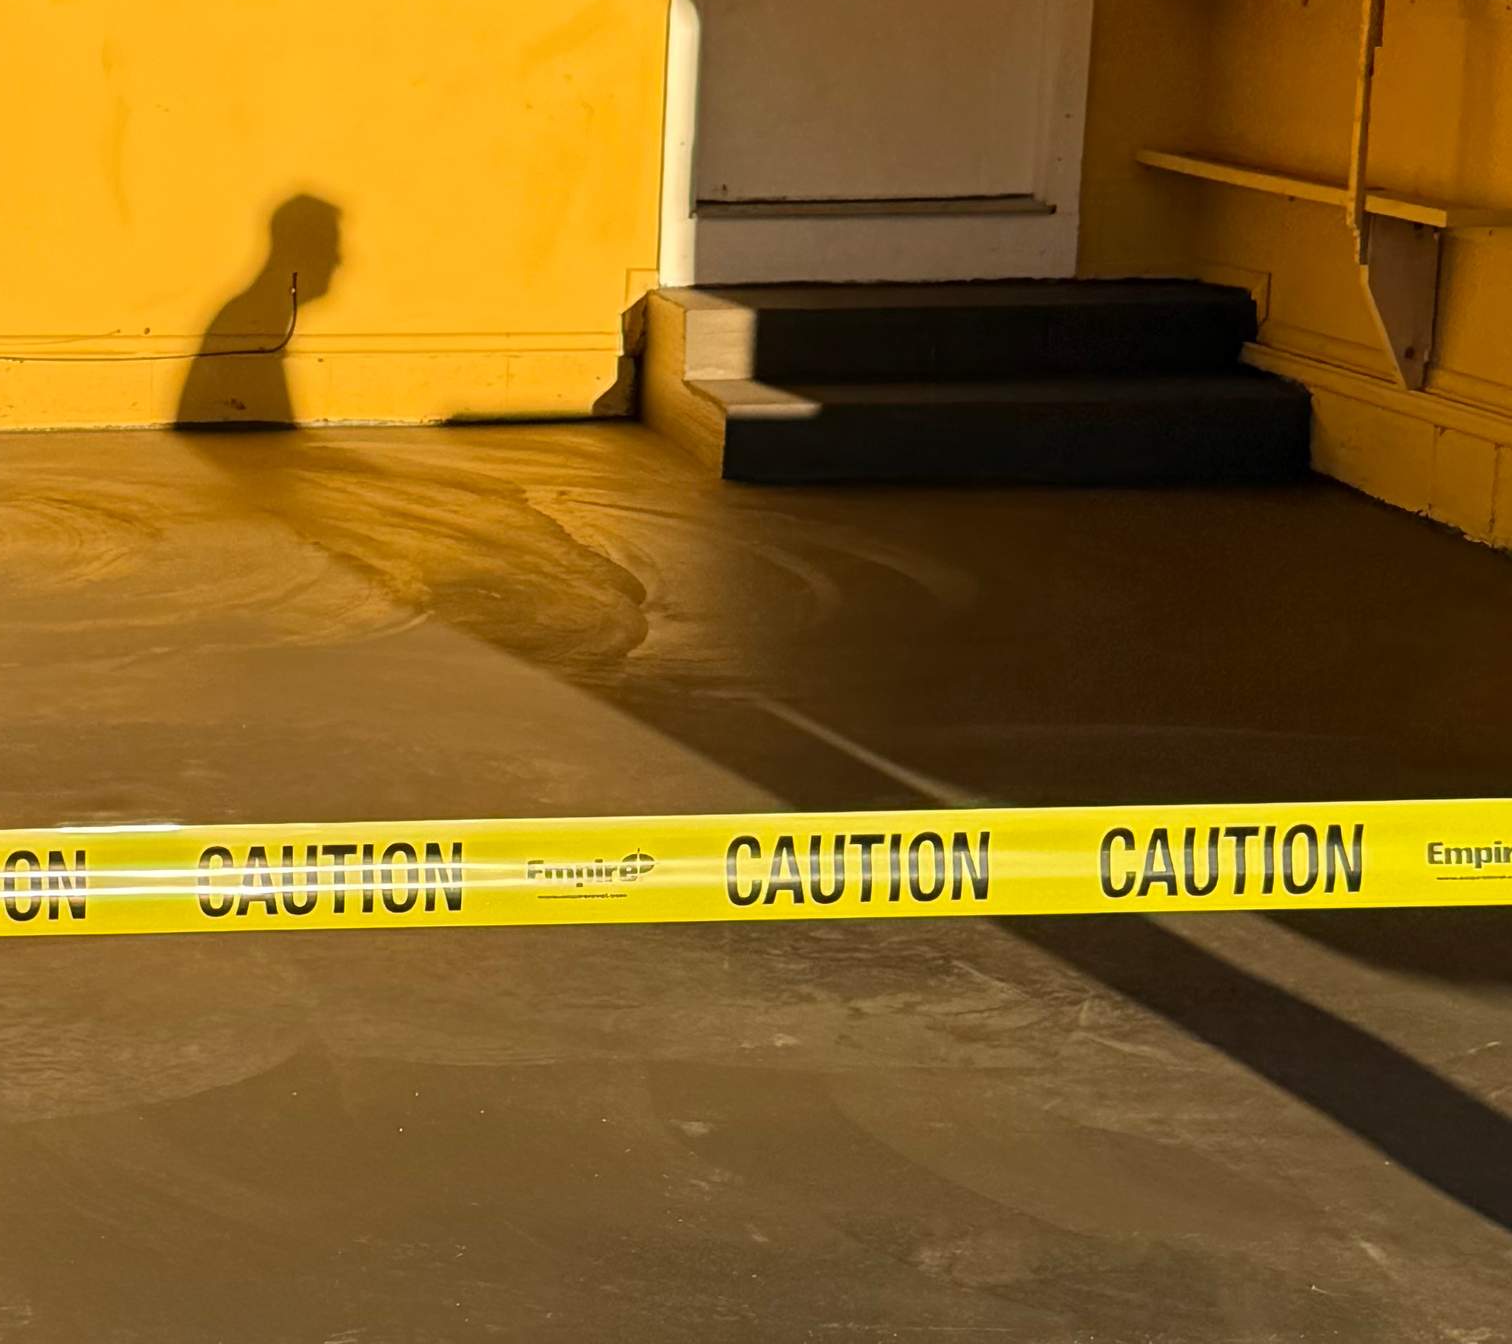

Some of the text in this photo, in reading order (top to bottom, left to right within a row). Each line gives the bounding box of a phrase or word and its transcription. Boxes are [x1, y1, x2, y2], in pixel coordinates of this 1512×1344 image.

[197, 842, 463, 918] CAUTION
[527, 859, 638, 888] Empire
[725, 831, 990, 907] CAUTION
[1099, 823, 1364, 899] CAUTION
